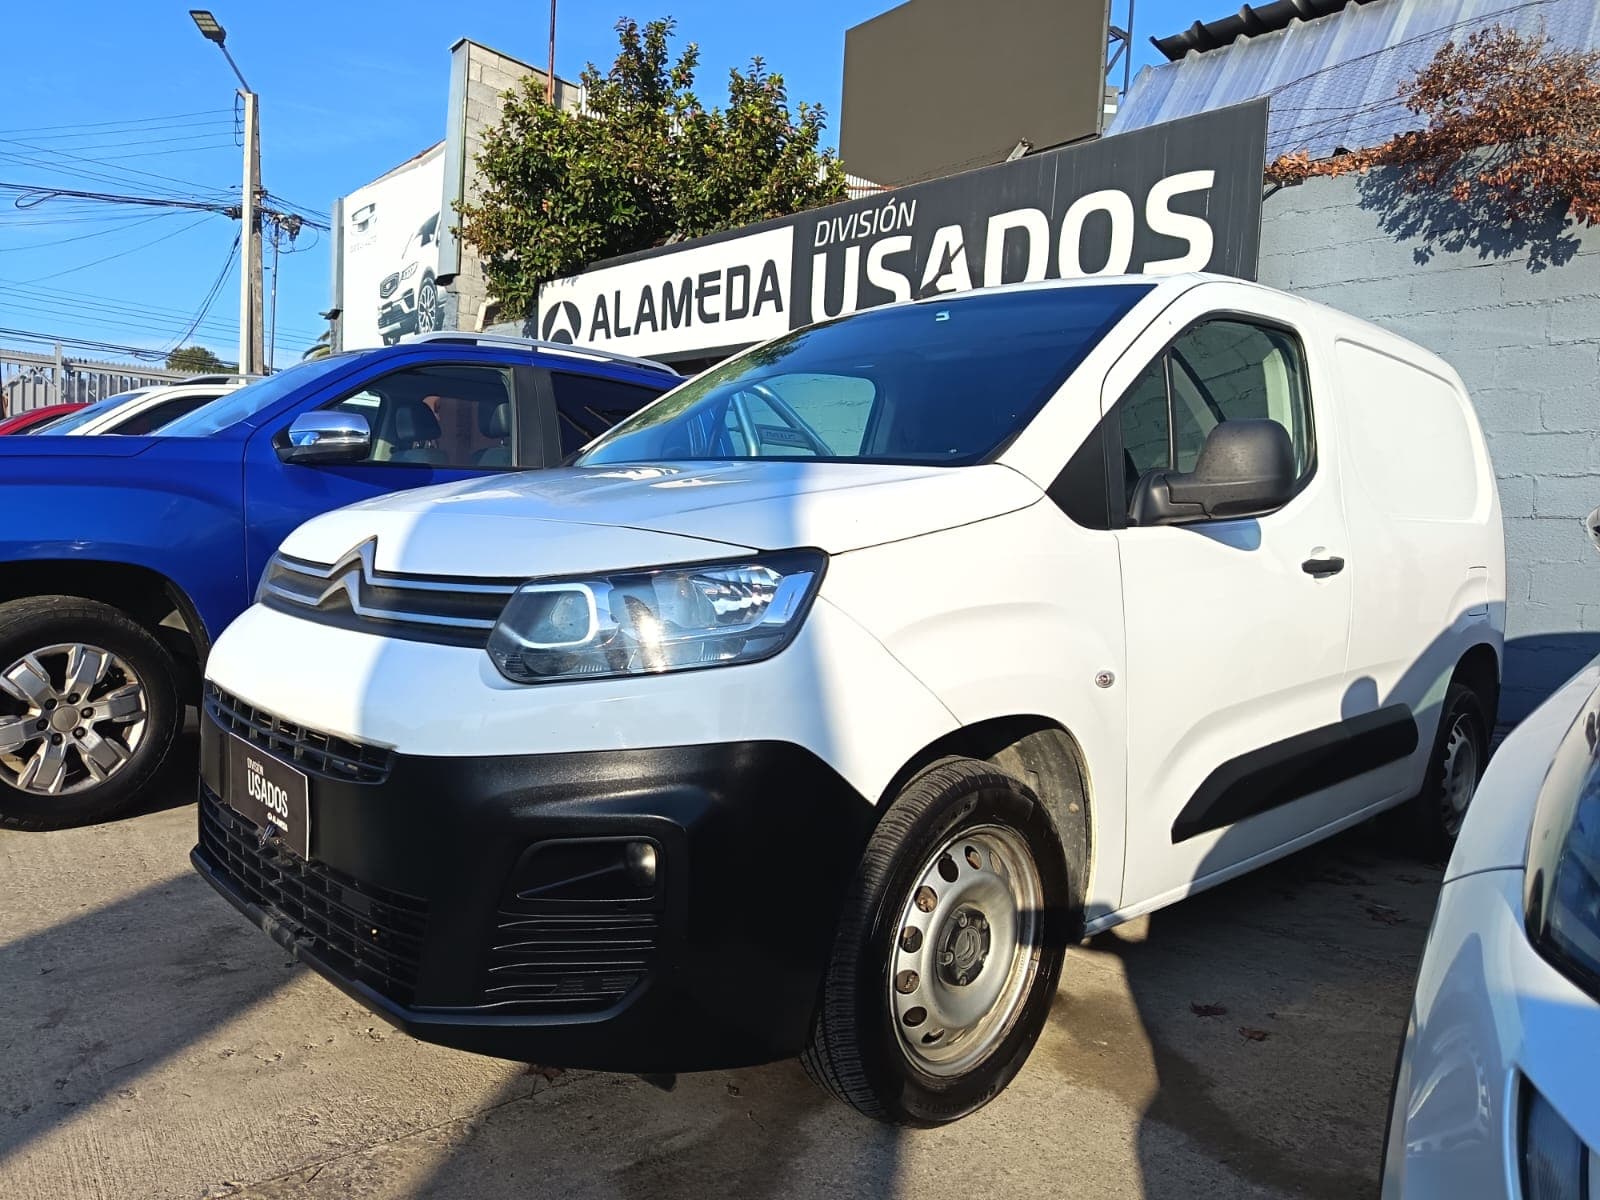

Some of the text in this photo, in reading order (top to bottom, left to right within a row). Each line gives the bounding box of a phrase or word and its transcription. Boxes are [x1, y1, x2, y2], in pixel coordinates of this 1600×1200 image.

[811, 170, 1215, 322] USADOS
[813, 197, 916, 248] DIVISIÓN
[588, 259, 784, 342] ALAMEDA
[247, 769, 288, 818] USADOS
